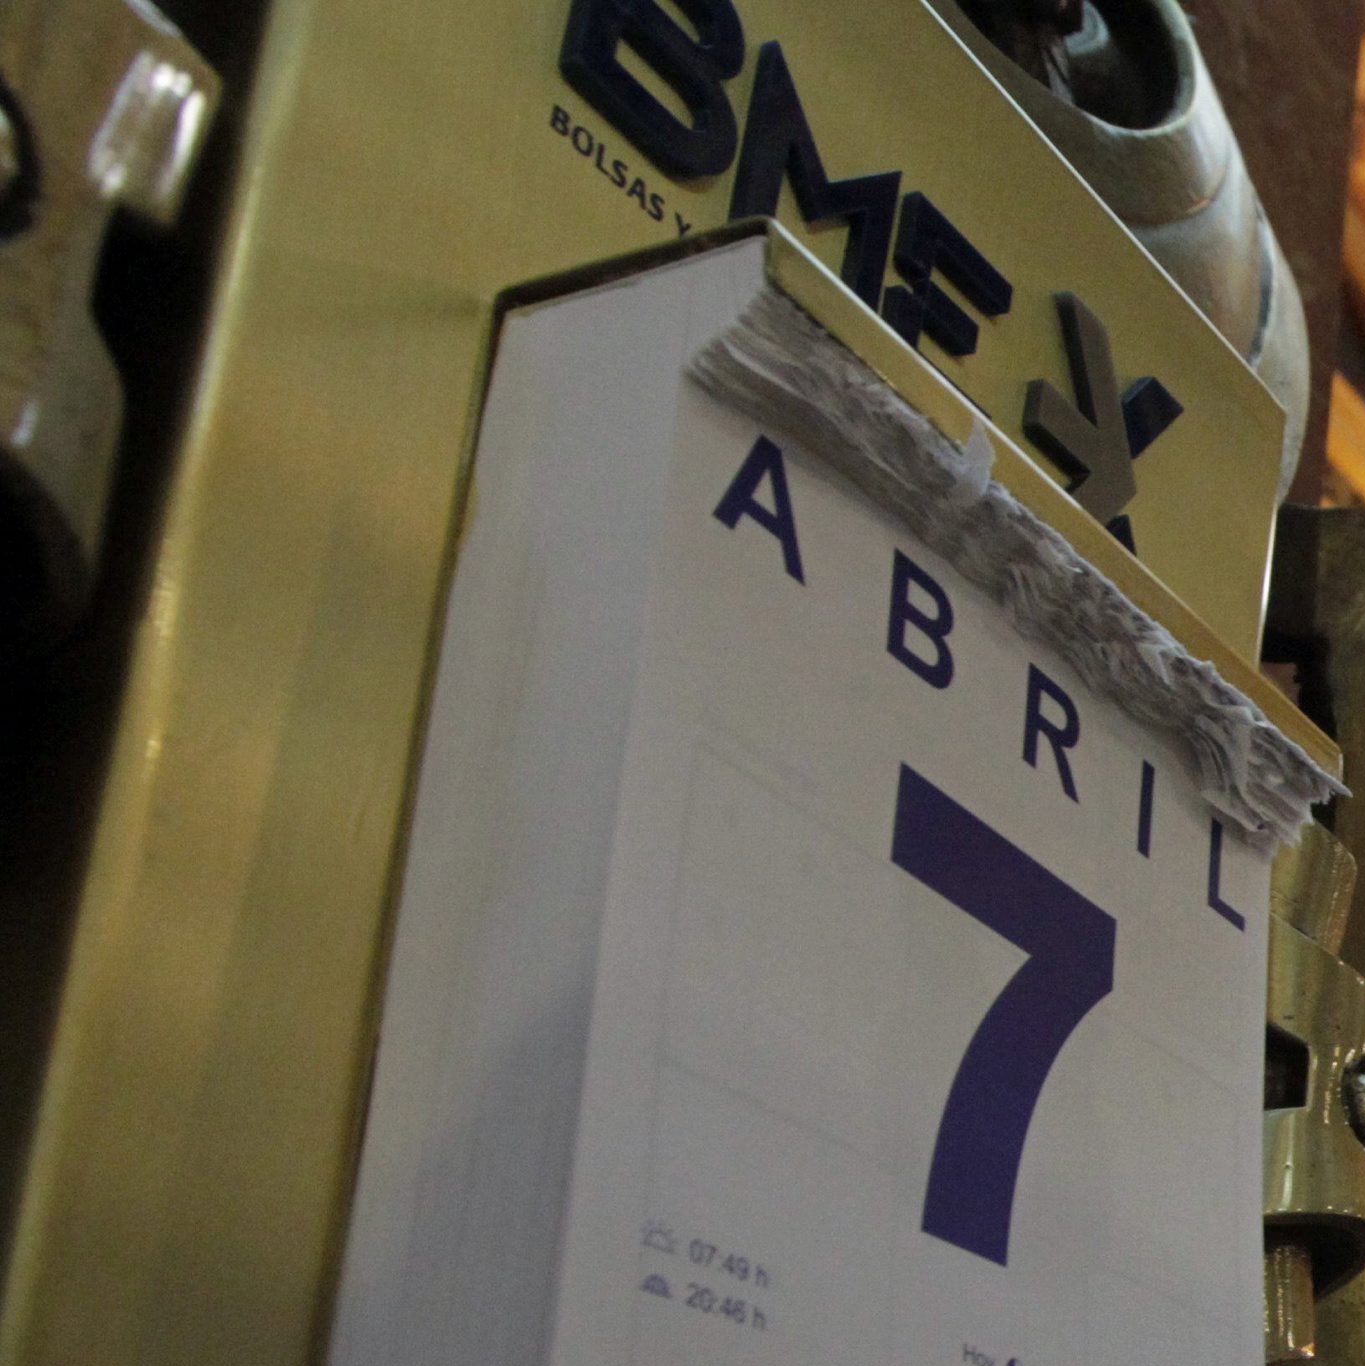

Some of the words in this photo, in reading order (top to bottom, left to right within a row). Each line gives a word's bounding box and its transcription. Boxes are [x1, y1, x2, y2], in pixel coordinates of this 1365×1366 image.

[549, 103, 666, 223] BOLSAS
[673, 211, 693, 240] Y
[713, 435, 1246, 932] ABRIL
[890, 761, 1118, 1268] 7
